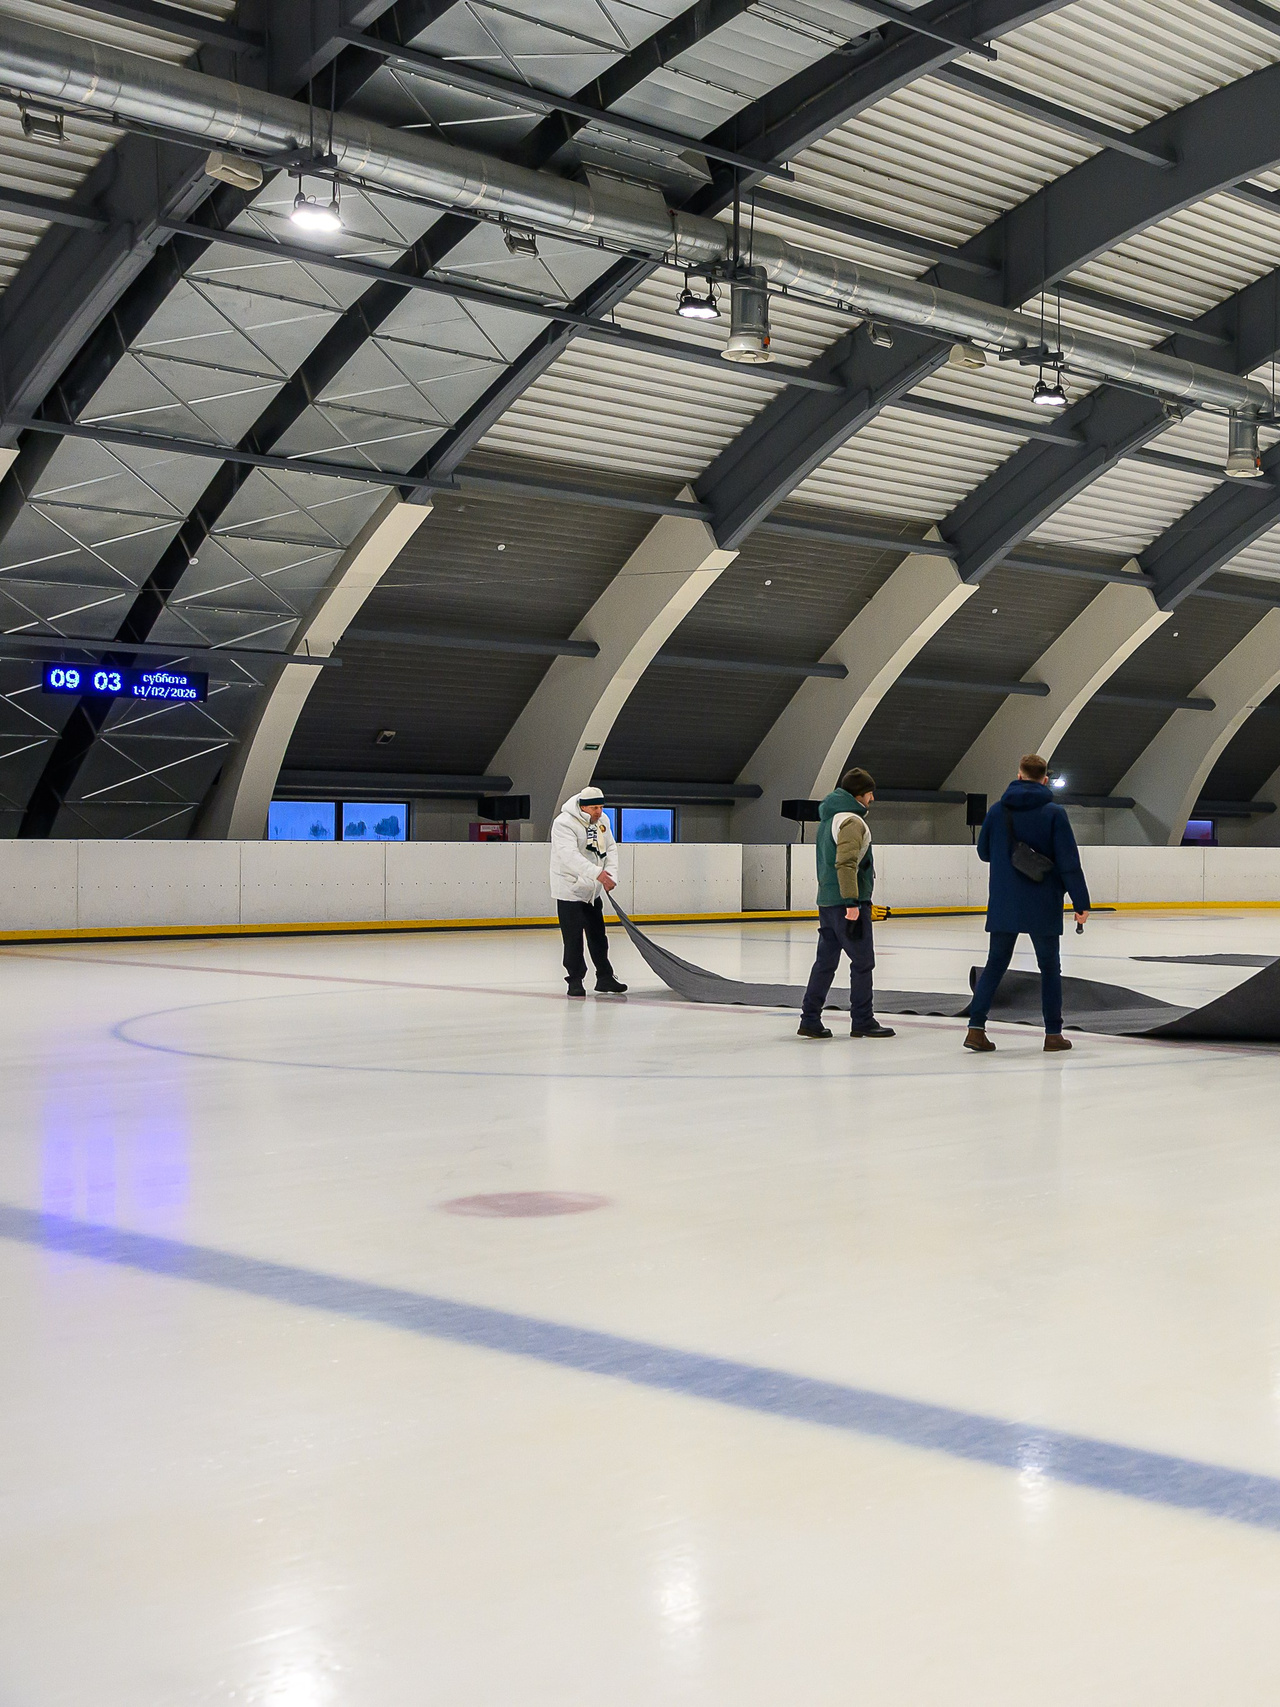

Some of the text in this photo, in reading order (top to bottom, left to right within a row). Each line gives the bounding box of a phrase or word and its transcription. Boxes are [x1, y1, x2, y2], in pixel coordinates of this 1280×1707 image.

[50, 668, 122, 691] 09 03
[142, 673, 187, 684] суббота
